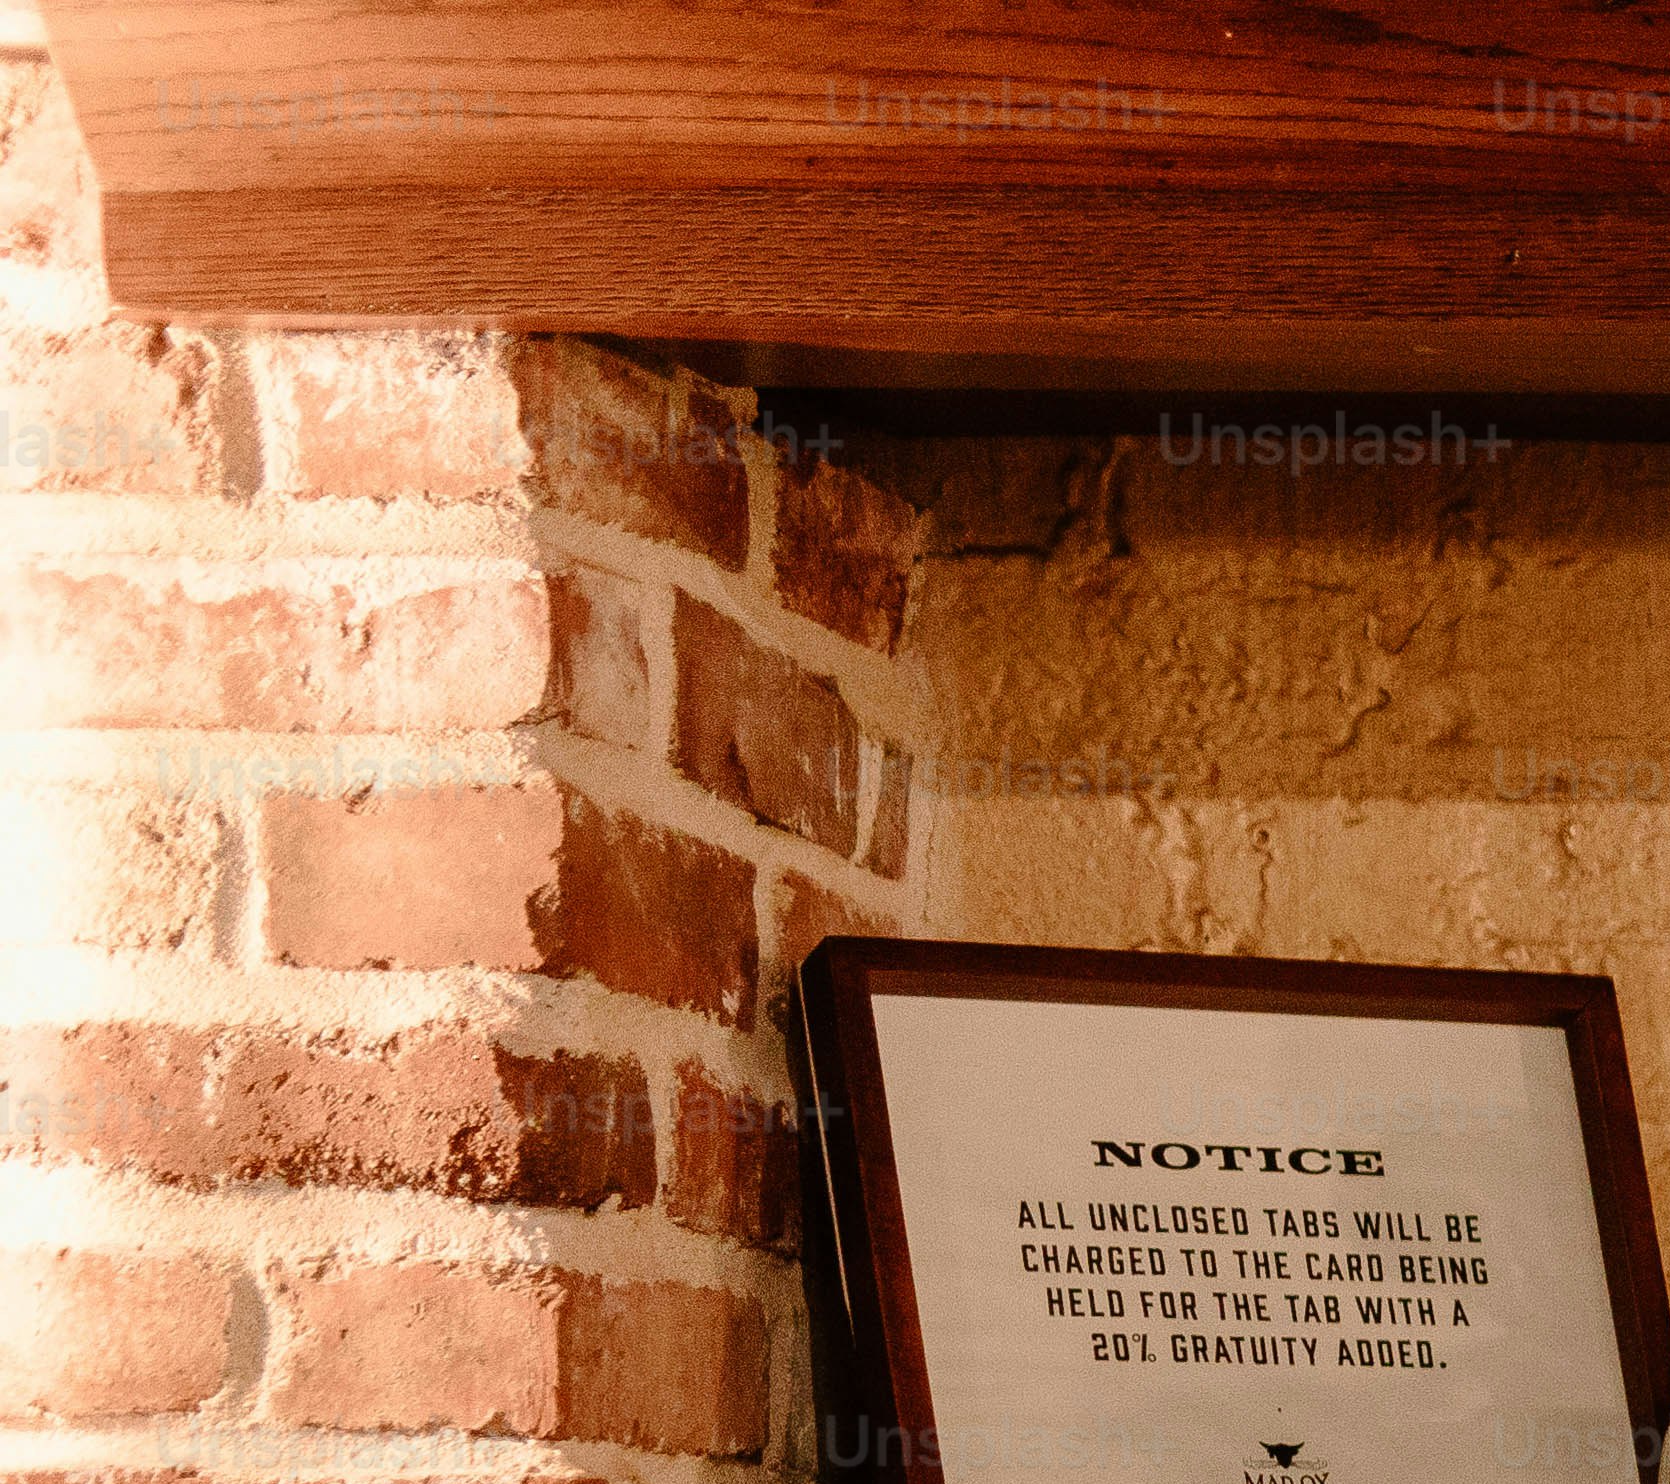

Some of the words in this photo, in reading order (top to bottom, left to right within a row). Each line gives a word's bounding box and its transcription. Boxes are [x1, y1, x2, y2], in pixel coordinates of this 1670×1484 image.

[1091, 1140, 1385, 1178] NOTICE
[1018, 1200, 1074, 1230] ALL
[1088, 1202, 1249, 1236] UNCLOSED
[1262, 1208, 1340, 1239] TABS
[1352, 1211, 1432, 1243] WILL
[1444, 1213, 1482, 1244] BE
[1021, 1243, 1166, 1276] CHARGED
[1179, 1248, 1218, 1278] TO
[1232, 1249, 1291, 1280] THE
[1305, 1252, 1384, 1283] CARD
[1398, 1254, 1489, 1286] BEING
[1046, 1287, 1125, 1318] HELD
[1139, 1290, 1198, 1321] FOR
[1212, 1291, 1271, 1322] THE
[1284, 1294, 1341, 1324] TAB
[1355, 1296, 1436, 1326] WITH
[1451, 1298, 1471, 1327] A
[1091, 1332, 1157, 1363] 20%
[1170, 1333, 1318, 1366] GRATUITY
[1337, 1338, 1448, 1370] ADDED.
